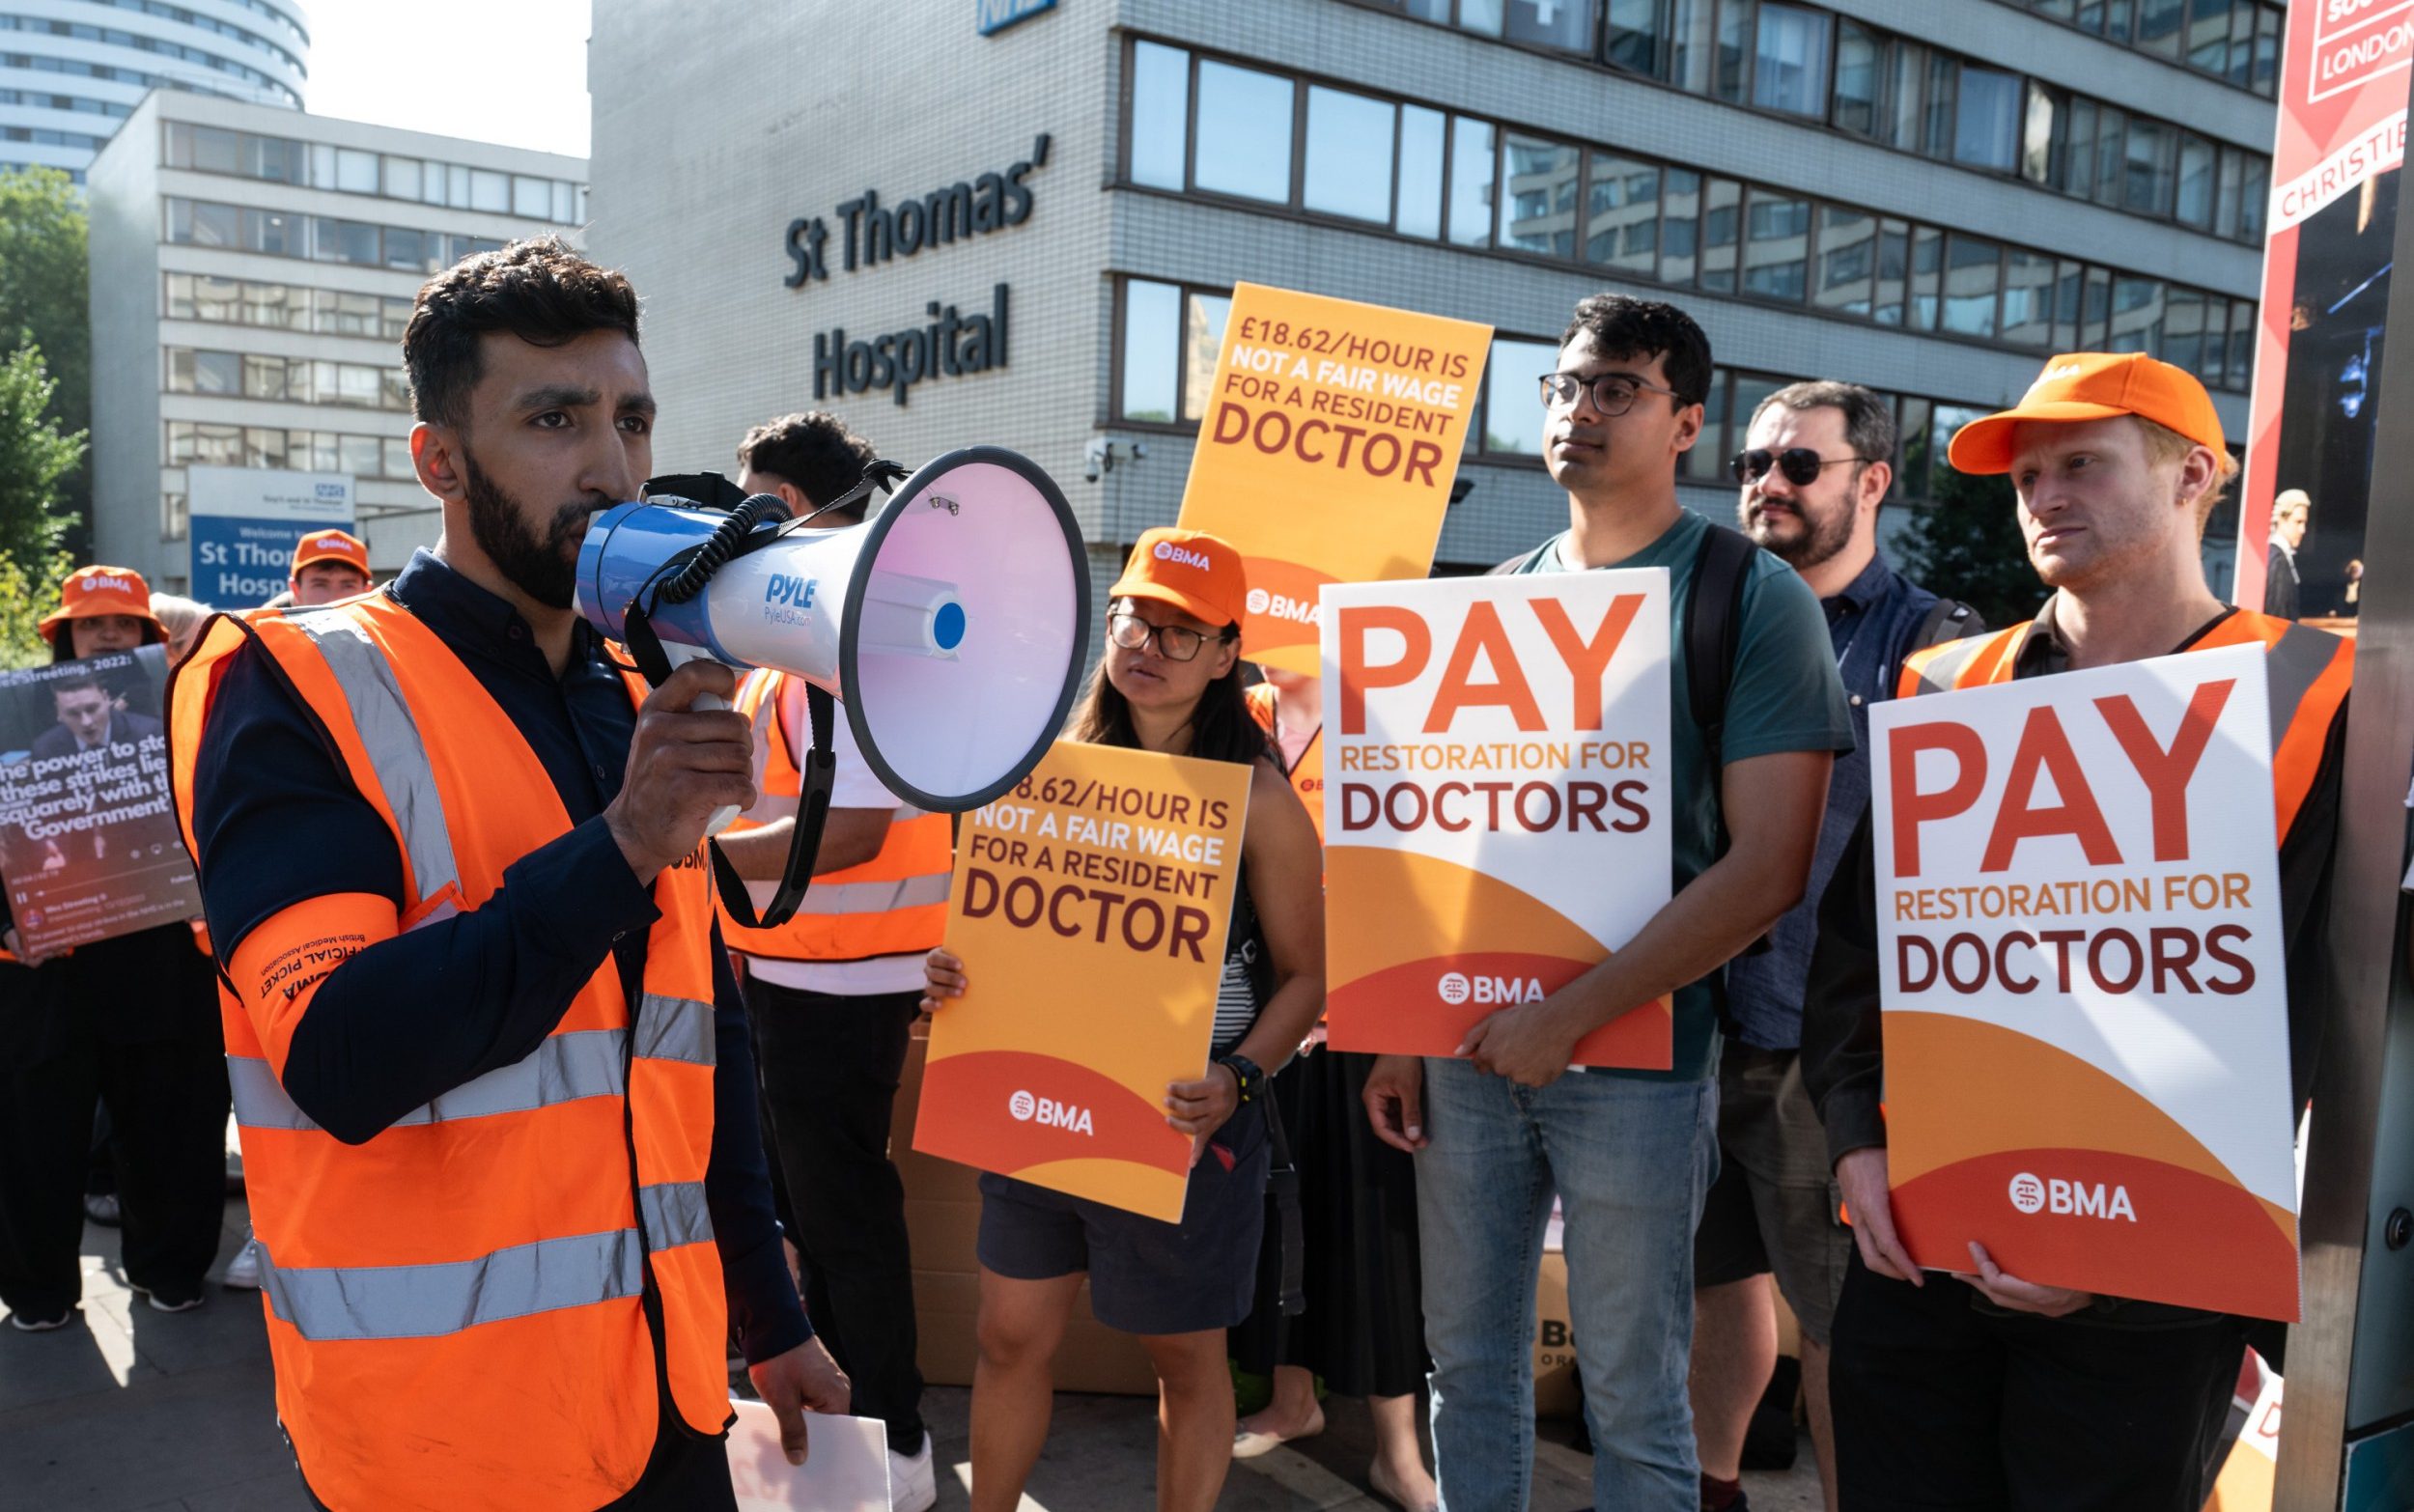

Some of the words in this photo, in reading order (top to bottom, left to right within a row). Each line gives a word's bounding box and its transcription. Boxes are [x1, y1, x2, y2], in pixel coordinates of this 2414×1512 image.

[2322, 20, 2414, 80] LONDON
[784, 216, 828, 288] St
[836, 132, 1052, 271] Thomas'
[813, 282, 1009, 406] Hospital
[1241, 317, 1434, 373] £18.62/HOUR
[1440, 352, 1470, 378] IS
[1230, 344, 1289, 375] NOT
[1290, 359, 1309, 380] A
[1316, 360, 1378, 393] FAIR
[1383, 373, 1464, 408] WAGE
[1224, 374, 1280, 403] FOR
[1284, 386, 1304, 407] A
[1310, 390, 1453, 435] RESIDENT
[1213, 402, 1443, 488] DOCTOR
[200, 542, 228, 565] St
[1171, 547, 1210, 572] BMA
[98, 575, 132, 595] BMA
[219, 572, 288, 597] Hosp
[94, 655, 132, 671] 2022:
[1338, 593, 1647, 735] PAY
[0, 760, 27, 781] he
[32, 746, 107, 780] power
[110, 742, 135, 758] to
[138, 734, 166, 753] sto
[1, 777, 62, 802] these
[66, 761, 138, 790] strikes
[140, 753, 167, 774] lie
[1340, 742, 1570, 772] RESTORATION
[1581, 741, 1650, 770] FOR
[1888, 678, 2237, 878] PAY
[0, 789, 97, 826] squarely
[99, 777, 152, 803] with
[1006, 774, 1191, 825] 8.62/HOUR
[1198, 798, 1229, 829] IS
[1341, 779, 1650, 833] DOCTORS
[683, 845, 709, 871] BM
[974, 802, 1035, 834] NOT
[1037, 812, 1058, 839] A
[1065, 816, 1131, 851] FAIR
[1137, 826, 1224, 866] WAGE
[969, 834, 1028, 867] FOR
[1033, 846, 1053, 872] A
[1063, 850, 1218, 900] RESIDENT
[962, 867, 1211, 964] DOCTOR
[1895, 877, 2150, 921] RESTORATION
[2164, 873, 2252, 911] FOR
[261, 946, 301, 976] Association
[303, 937, 337, 951] Medical
[339, 934, 366, 942] British
[1896, 923, 2256, 995] DOCTORS
[261, 959, 302, 998] PICKET
[1474, 975, 1545, 1005] BMA
[1035, 1097, 1093, 1136] BMA
[2048, 1178, 2137, 1222] BMA
